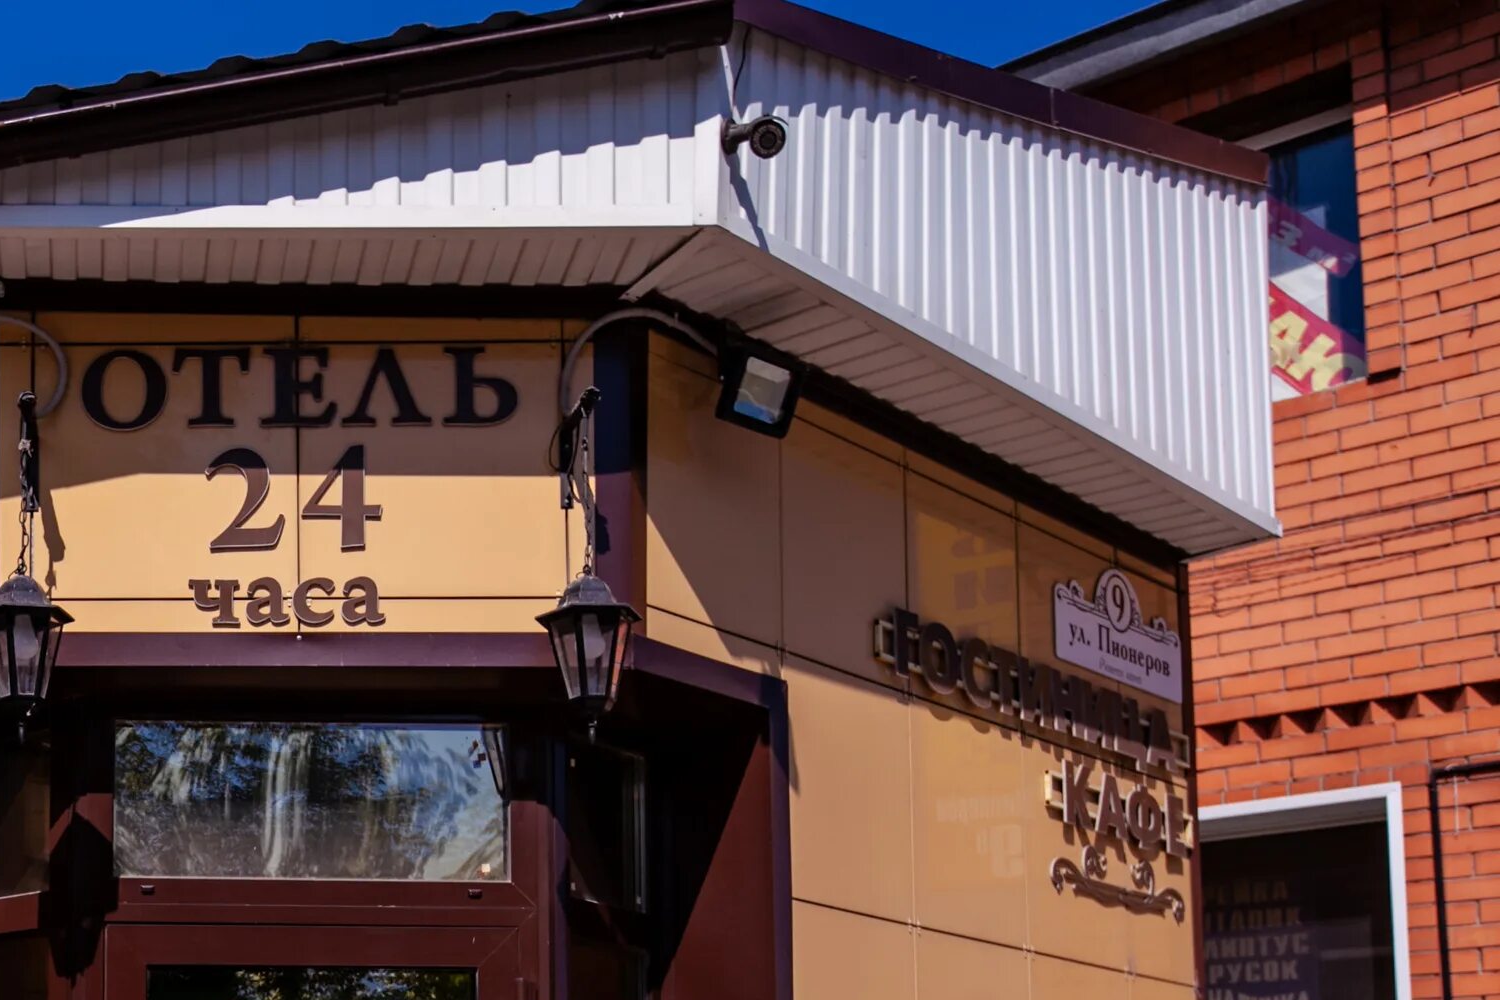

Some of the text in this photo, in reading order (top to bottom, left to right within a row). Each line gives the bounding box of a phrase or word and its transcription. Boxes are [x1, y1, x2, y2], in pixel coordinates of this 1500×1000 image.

[81, 346, 519, 431] ОТЕЛЬ
[1268, 297, 1366, 392] АЮ
[205, 444, 382, 552] 24
[188, 575, 386, 628] часа
[1112, 585, 1124, 622] 9
[891, 607, 1178, 772] ГОСТИНИЦА
[1069, 623, 1091, 647] ул.
[1098, 624, 1171, 676] Пионеров
[1061, 758, 1193, 859] КАФЕ
